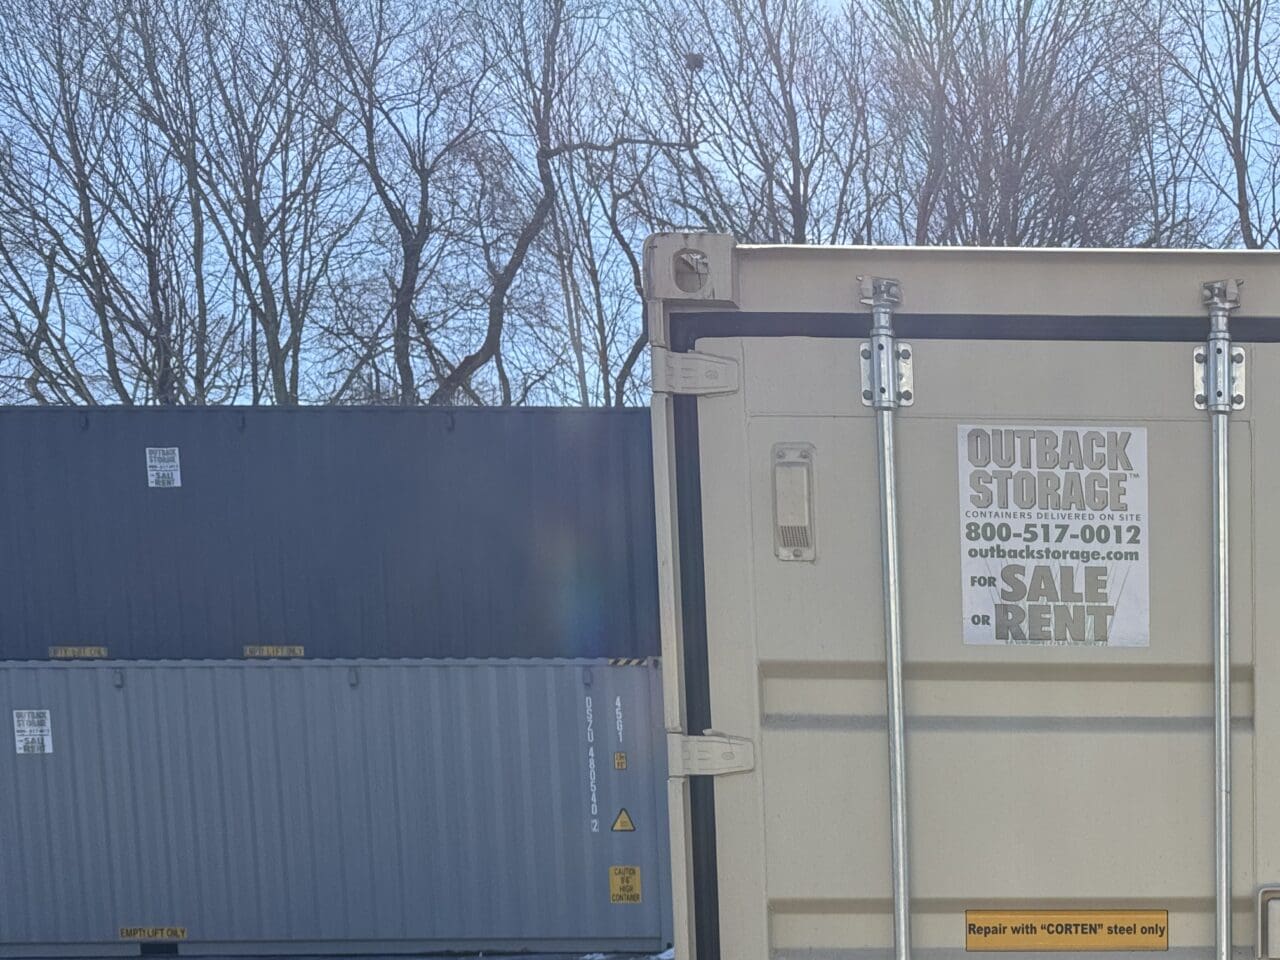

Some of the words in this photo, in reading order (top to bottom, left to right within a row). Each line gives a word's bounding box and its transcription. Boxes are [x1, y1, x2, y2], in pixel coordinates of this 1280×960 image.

[967, 428, 1133, 470] OUTBACK
[969, 470, 1128, 511] STORAGE
[965, 511, 1032, 519] CONTAINERS
[1037, 512, 1095, 521] DELIVERED
[1100, 513, 1114, 521] ON
[1119, 513, 1141, 522] SITE
[965, 522, 1141, 544] 800-517-0012
[968, 544, 1139, 563] outbackstorage.com
[970, 576, 997, 588] FOR
[1000, 564, 1108, 603] SALE
[971, 615, 990, 626] OR
[995, 604, 1114, 641] RENT
[968, 923, 1008, 938] Repair
[1010, 923, 1037, 935] with
[1107, 923, 1137, 935] steel
[1140, 923, 1166, 938] only
